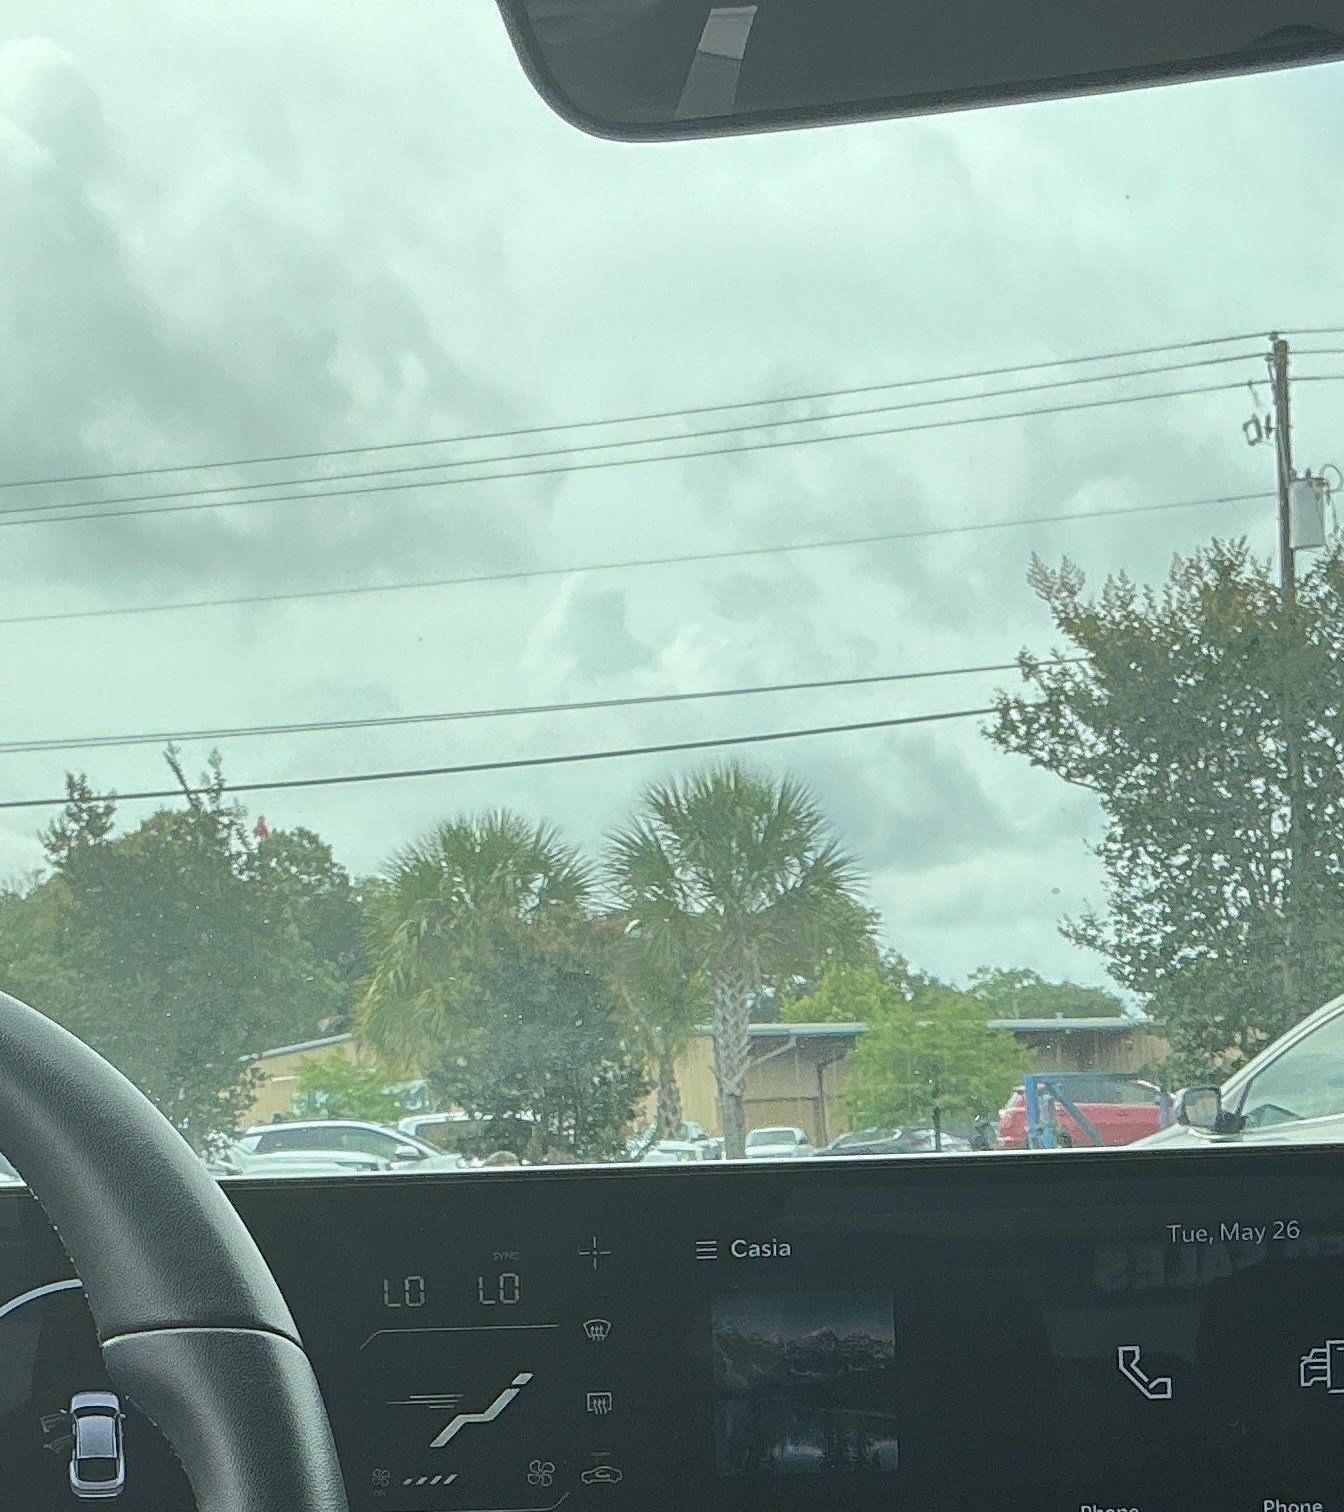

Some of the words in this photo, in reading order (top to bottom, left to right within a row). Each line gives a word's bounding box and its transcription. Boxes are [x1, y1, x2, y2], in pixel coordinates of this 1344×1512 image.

[1167, 1225, 1213, 1244] Tue,
[1221, 1223, 1265, 1244] May
[1273, 1220, 1300, 1239] 26
[732, 1239, 790, 1257] Casia
[384, 1276, 424, 1307] LO
[479, 1273, 519, 1304] LO
